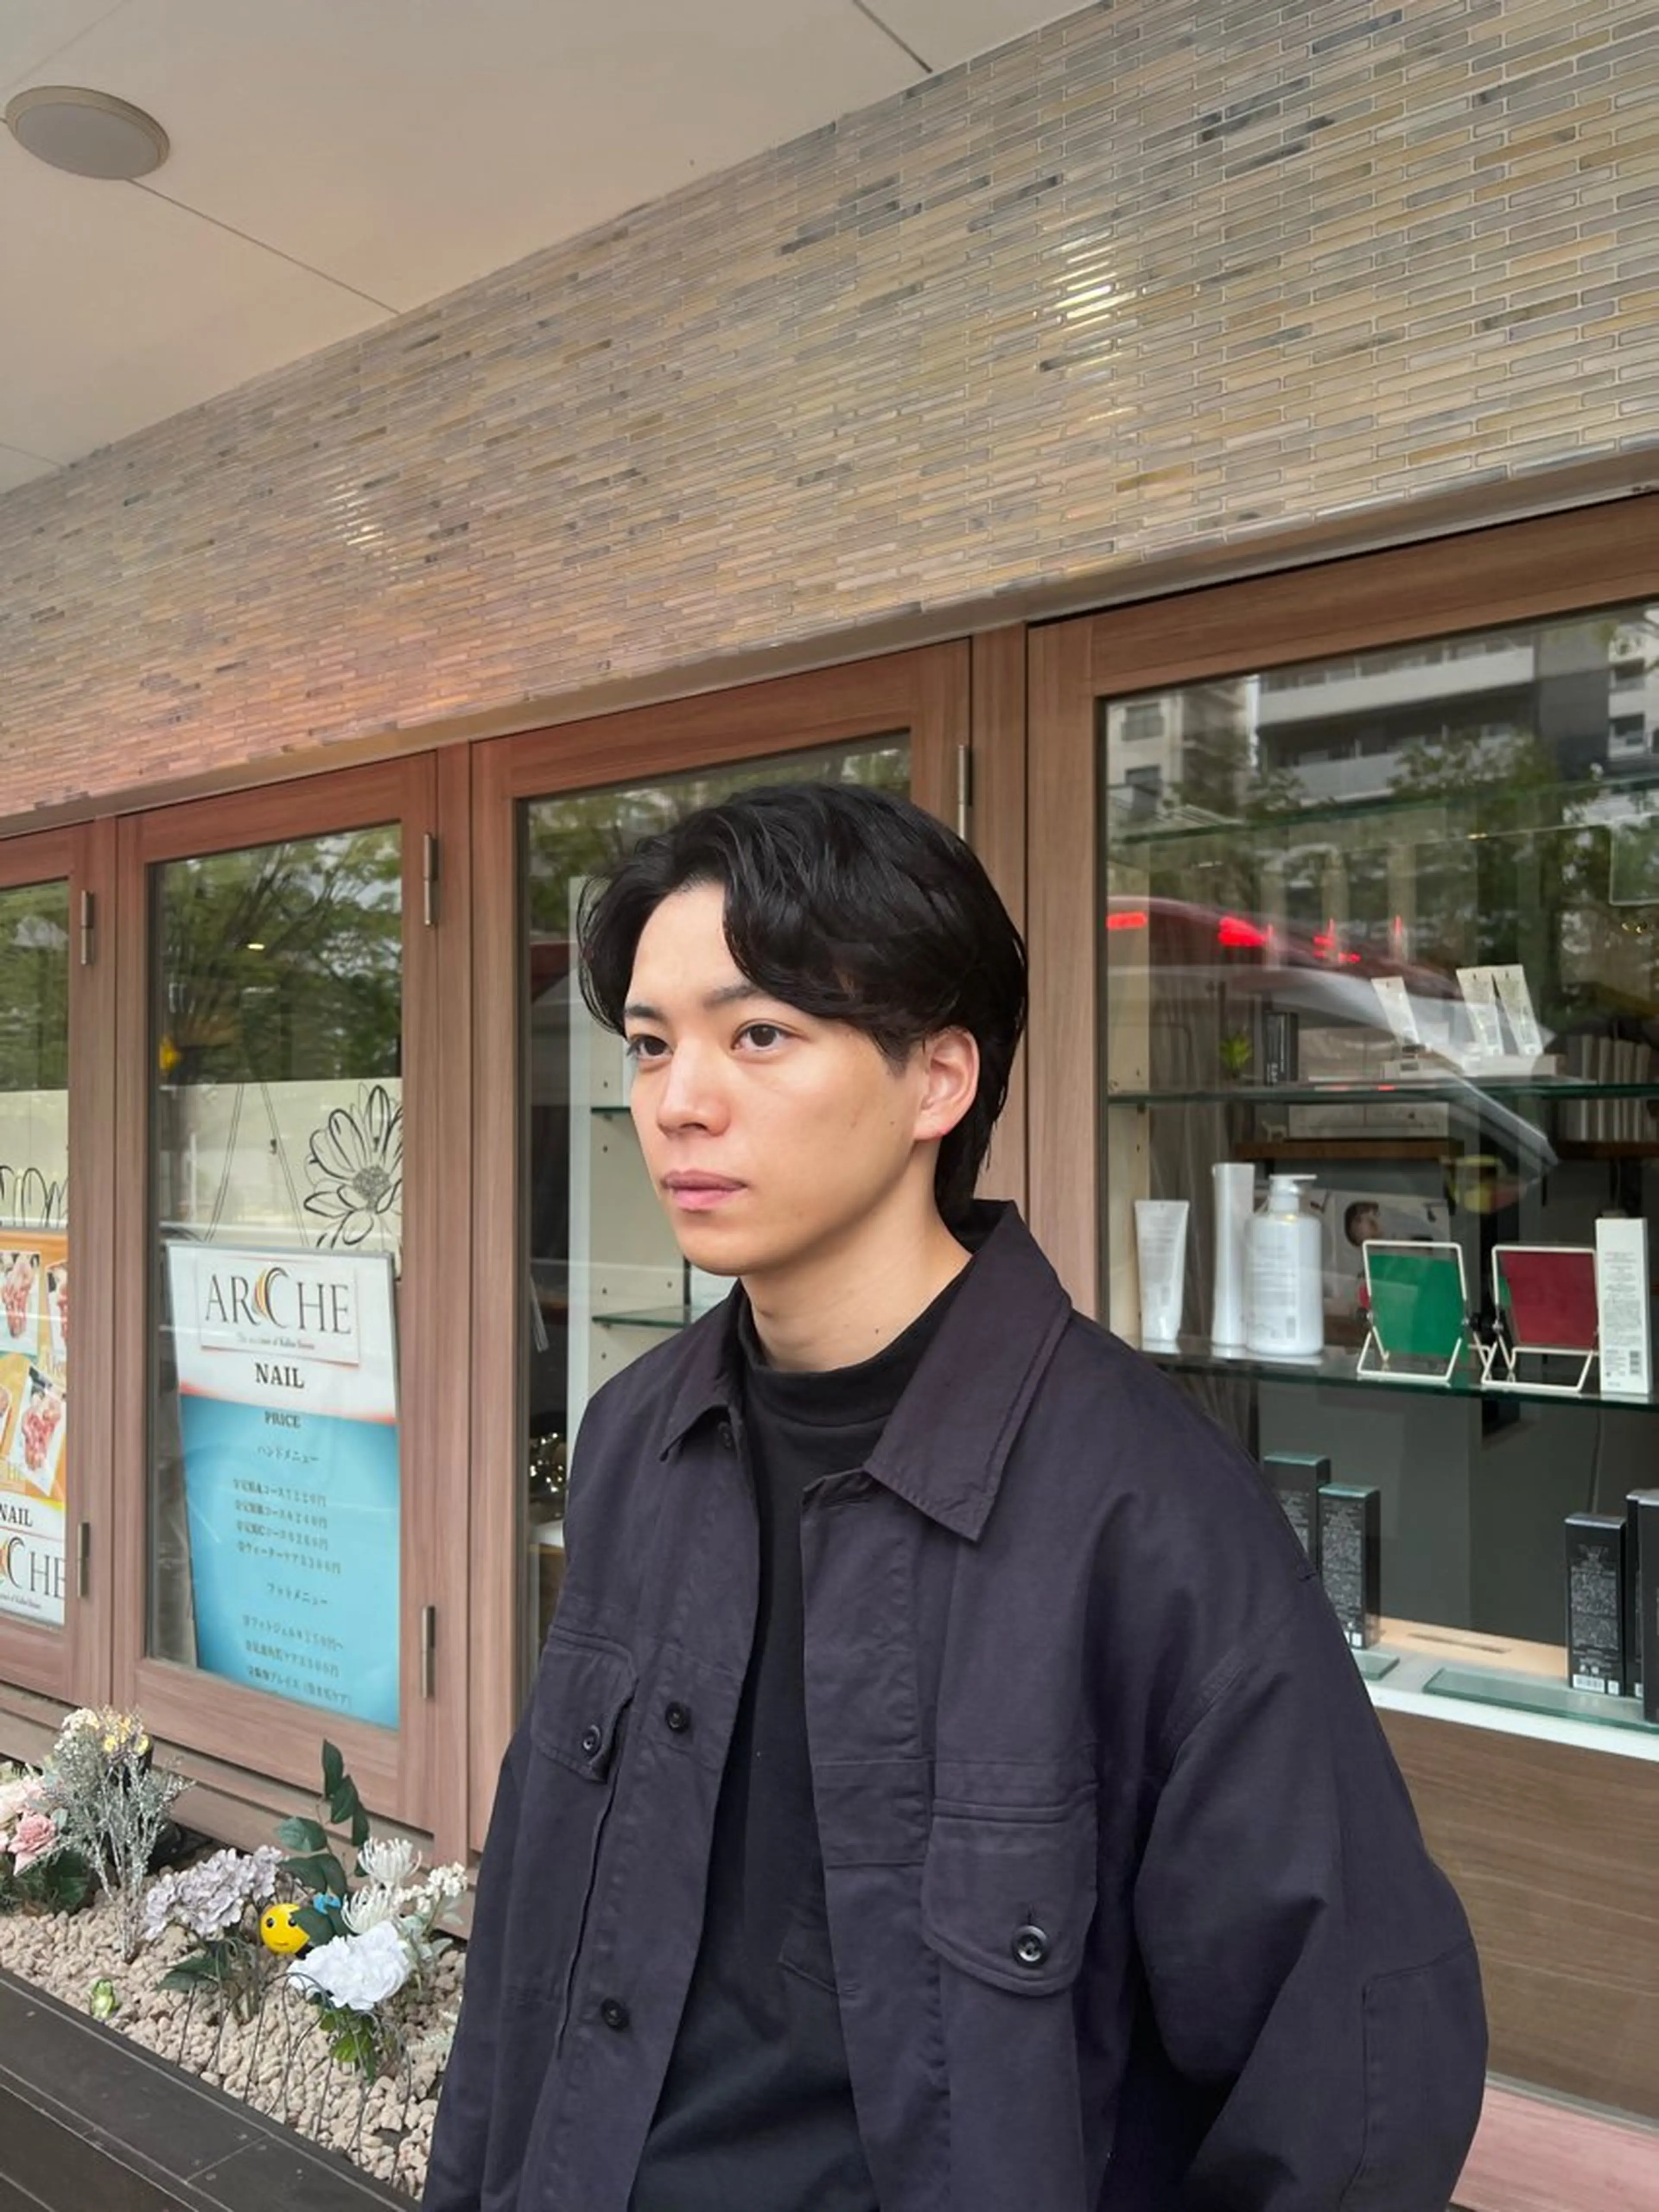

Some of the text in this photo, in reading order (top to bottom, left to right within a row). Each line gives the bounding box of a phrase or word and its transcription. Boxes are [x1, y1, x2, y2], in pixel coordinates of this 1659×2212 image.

[205, 1267, 351, 1335] ARCHE
[255, 1363, 305, 1389] NAIL
[265, 1411, 301, 1429] PRICE
